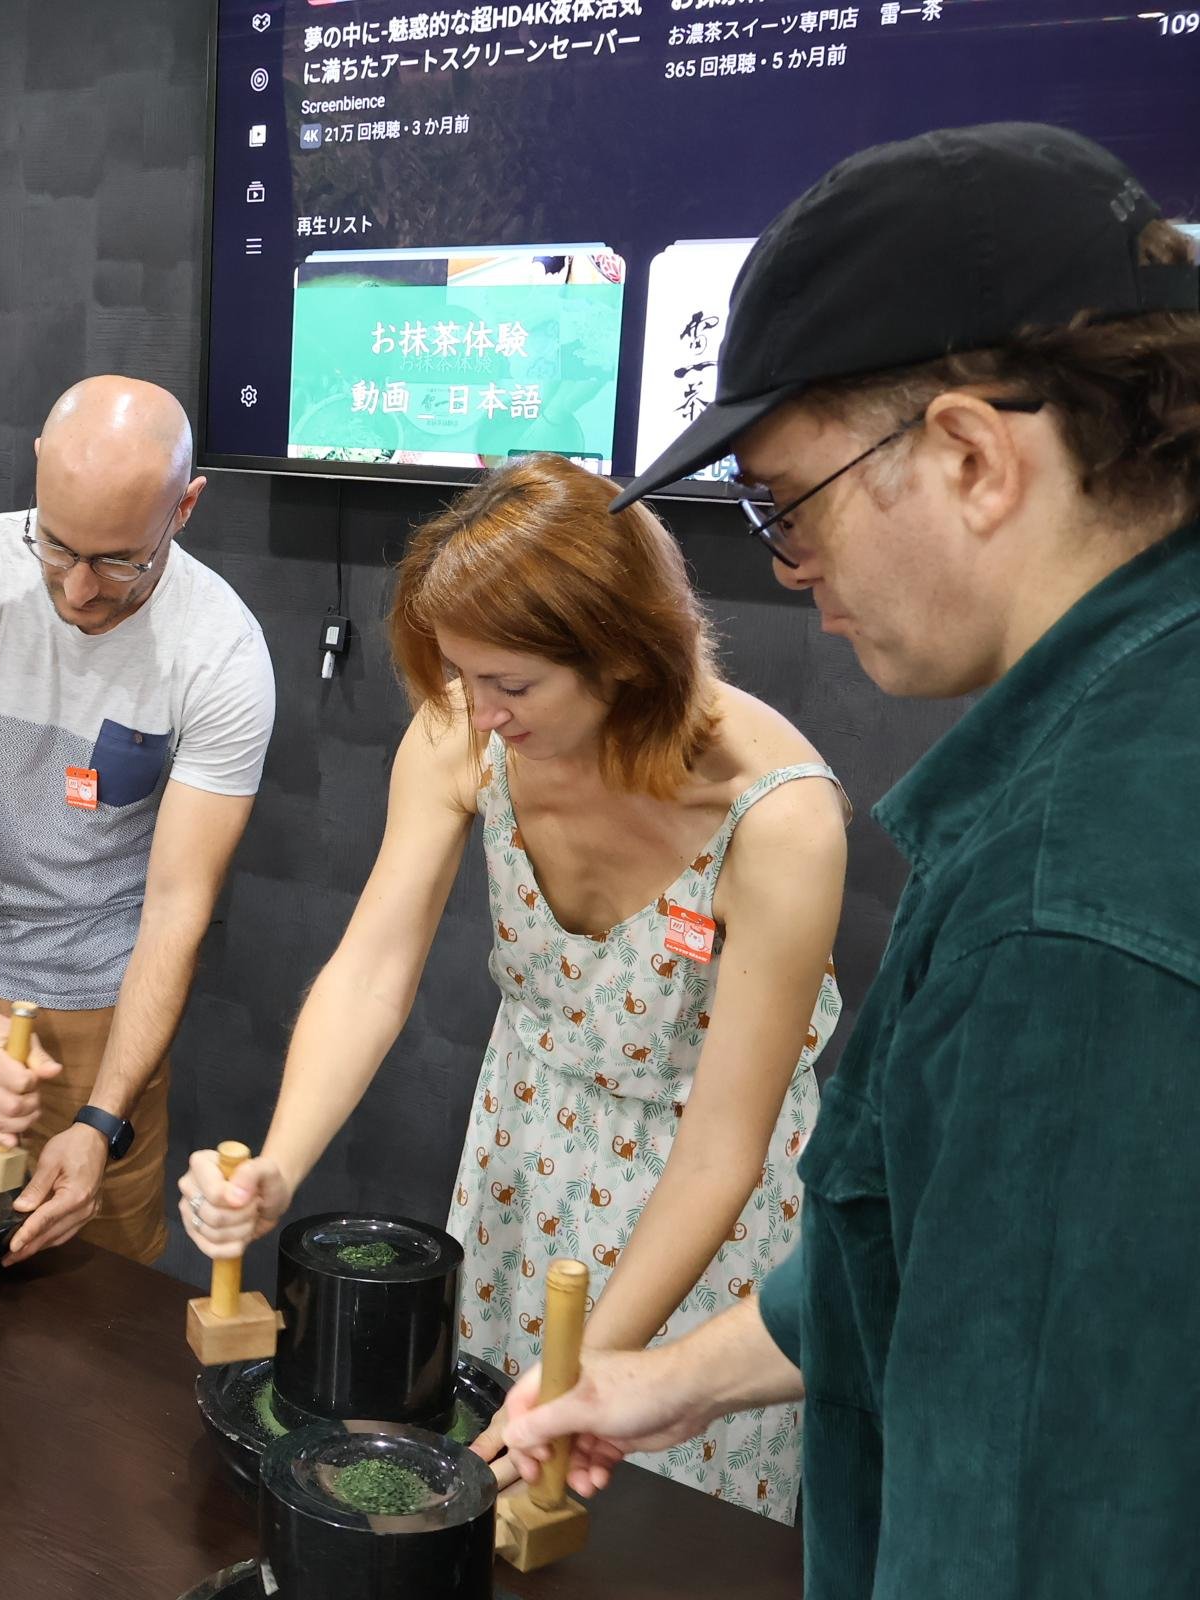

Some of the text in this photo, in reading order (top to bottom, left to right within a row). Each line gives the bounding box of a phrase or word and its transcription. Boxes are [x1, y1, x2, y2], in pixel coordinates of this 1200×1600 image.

[668, 7, 859, 46] お濃茶スイーツ専門店
[303, 28, 641, 85] に満ちたアートスクリーンセーバー
[664, 60, 696, 79] 365
[301, 95, 386, 115] Screenbience
[303, 128, 319, 143] 4K
[296, 214, 373, 237] 再生リスト
[370, 319, 529, 358] お抹茶体験
